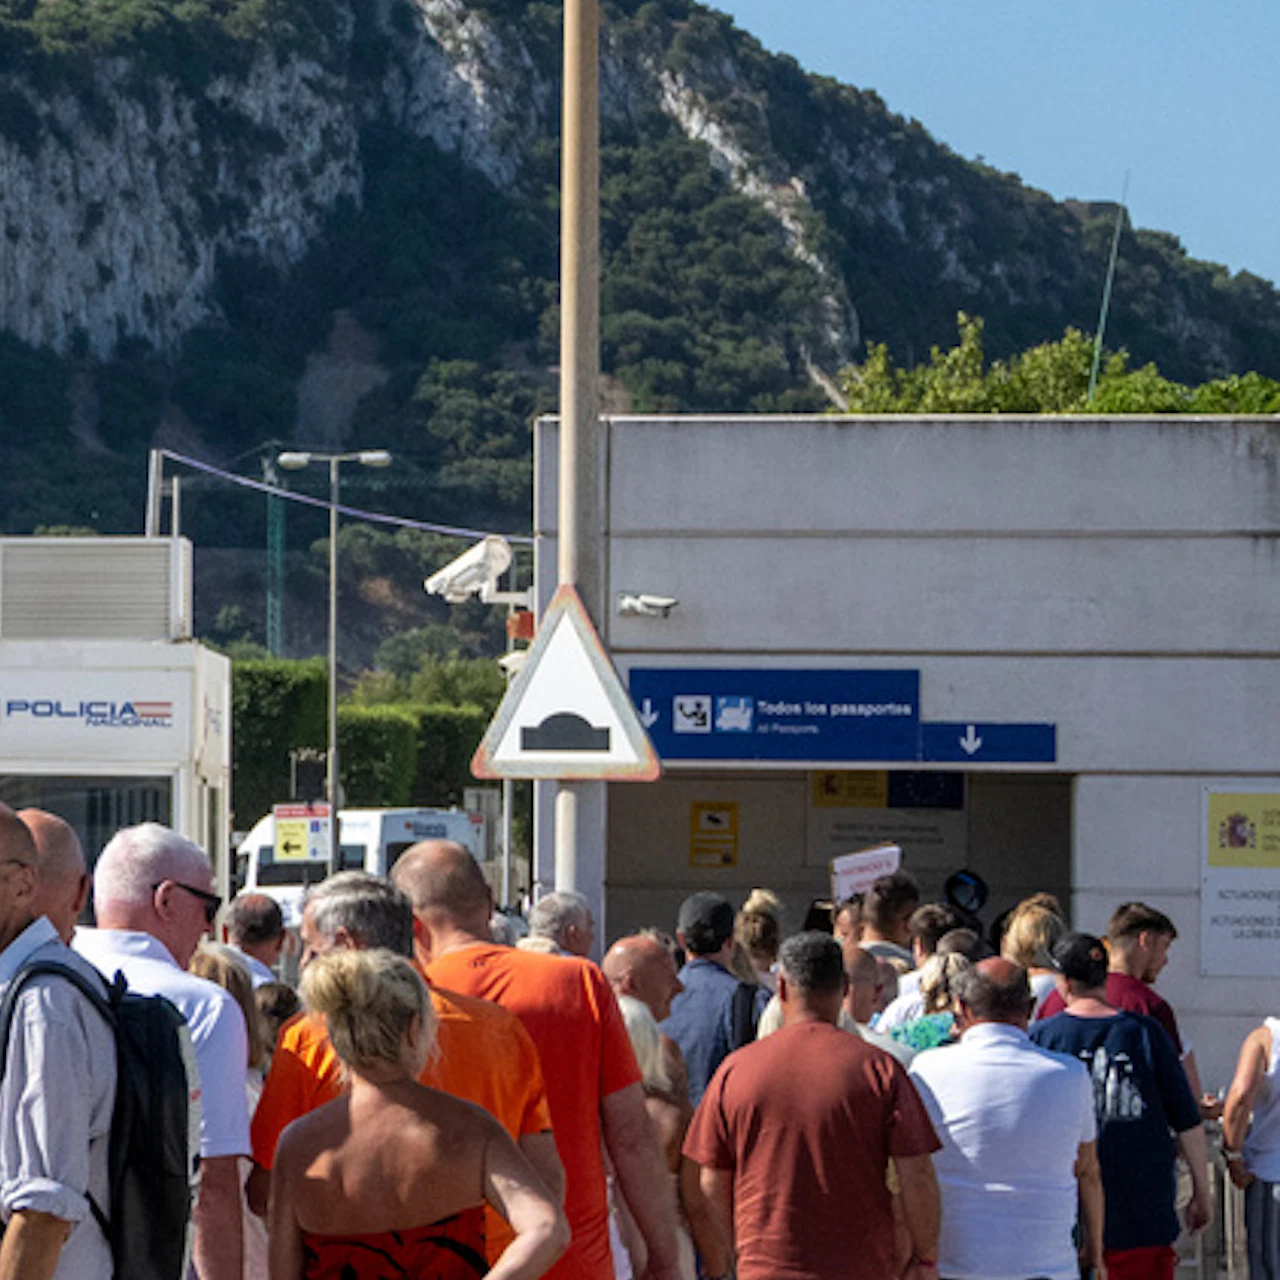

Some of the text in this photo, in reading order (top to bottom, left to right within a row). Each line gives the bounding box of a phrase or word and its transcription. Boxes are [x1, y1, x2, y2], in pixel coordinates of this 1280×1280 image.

[6, 700, 138, 718] POLICIA
[757, 699, 913, 718] Todos los pasaportes
[85, 717, 174, 728] NACIONAL
